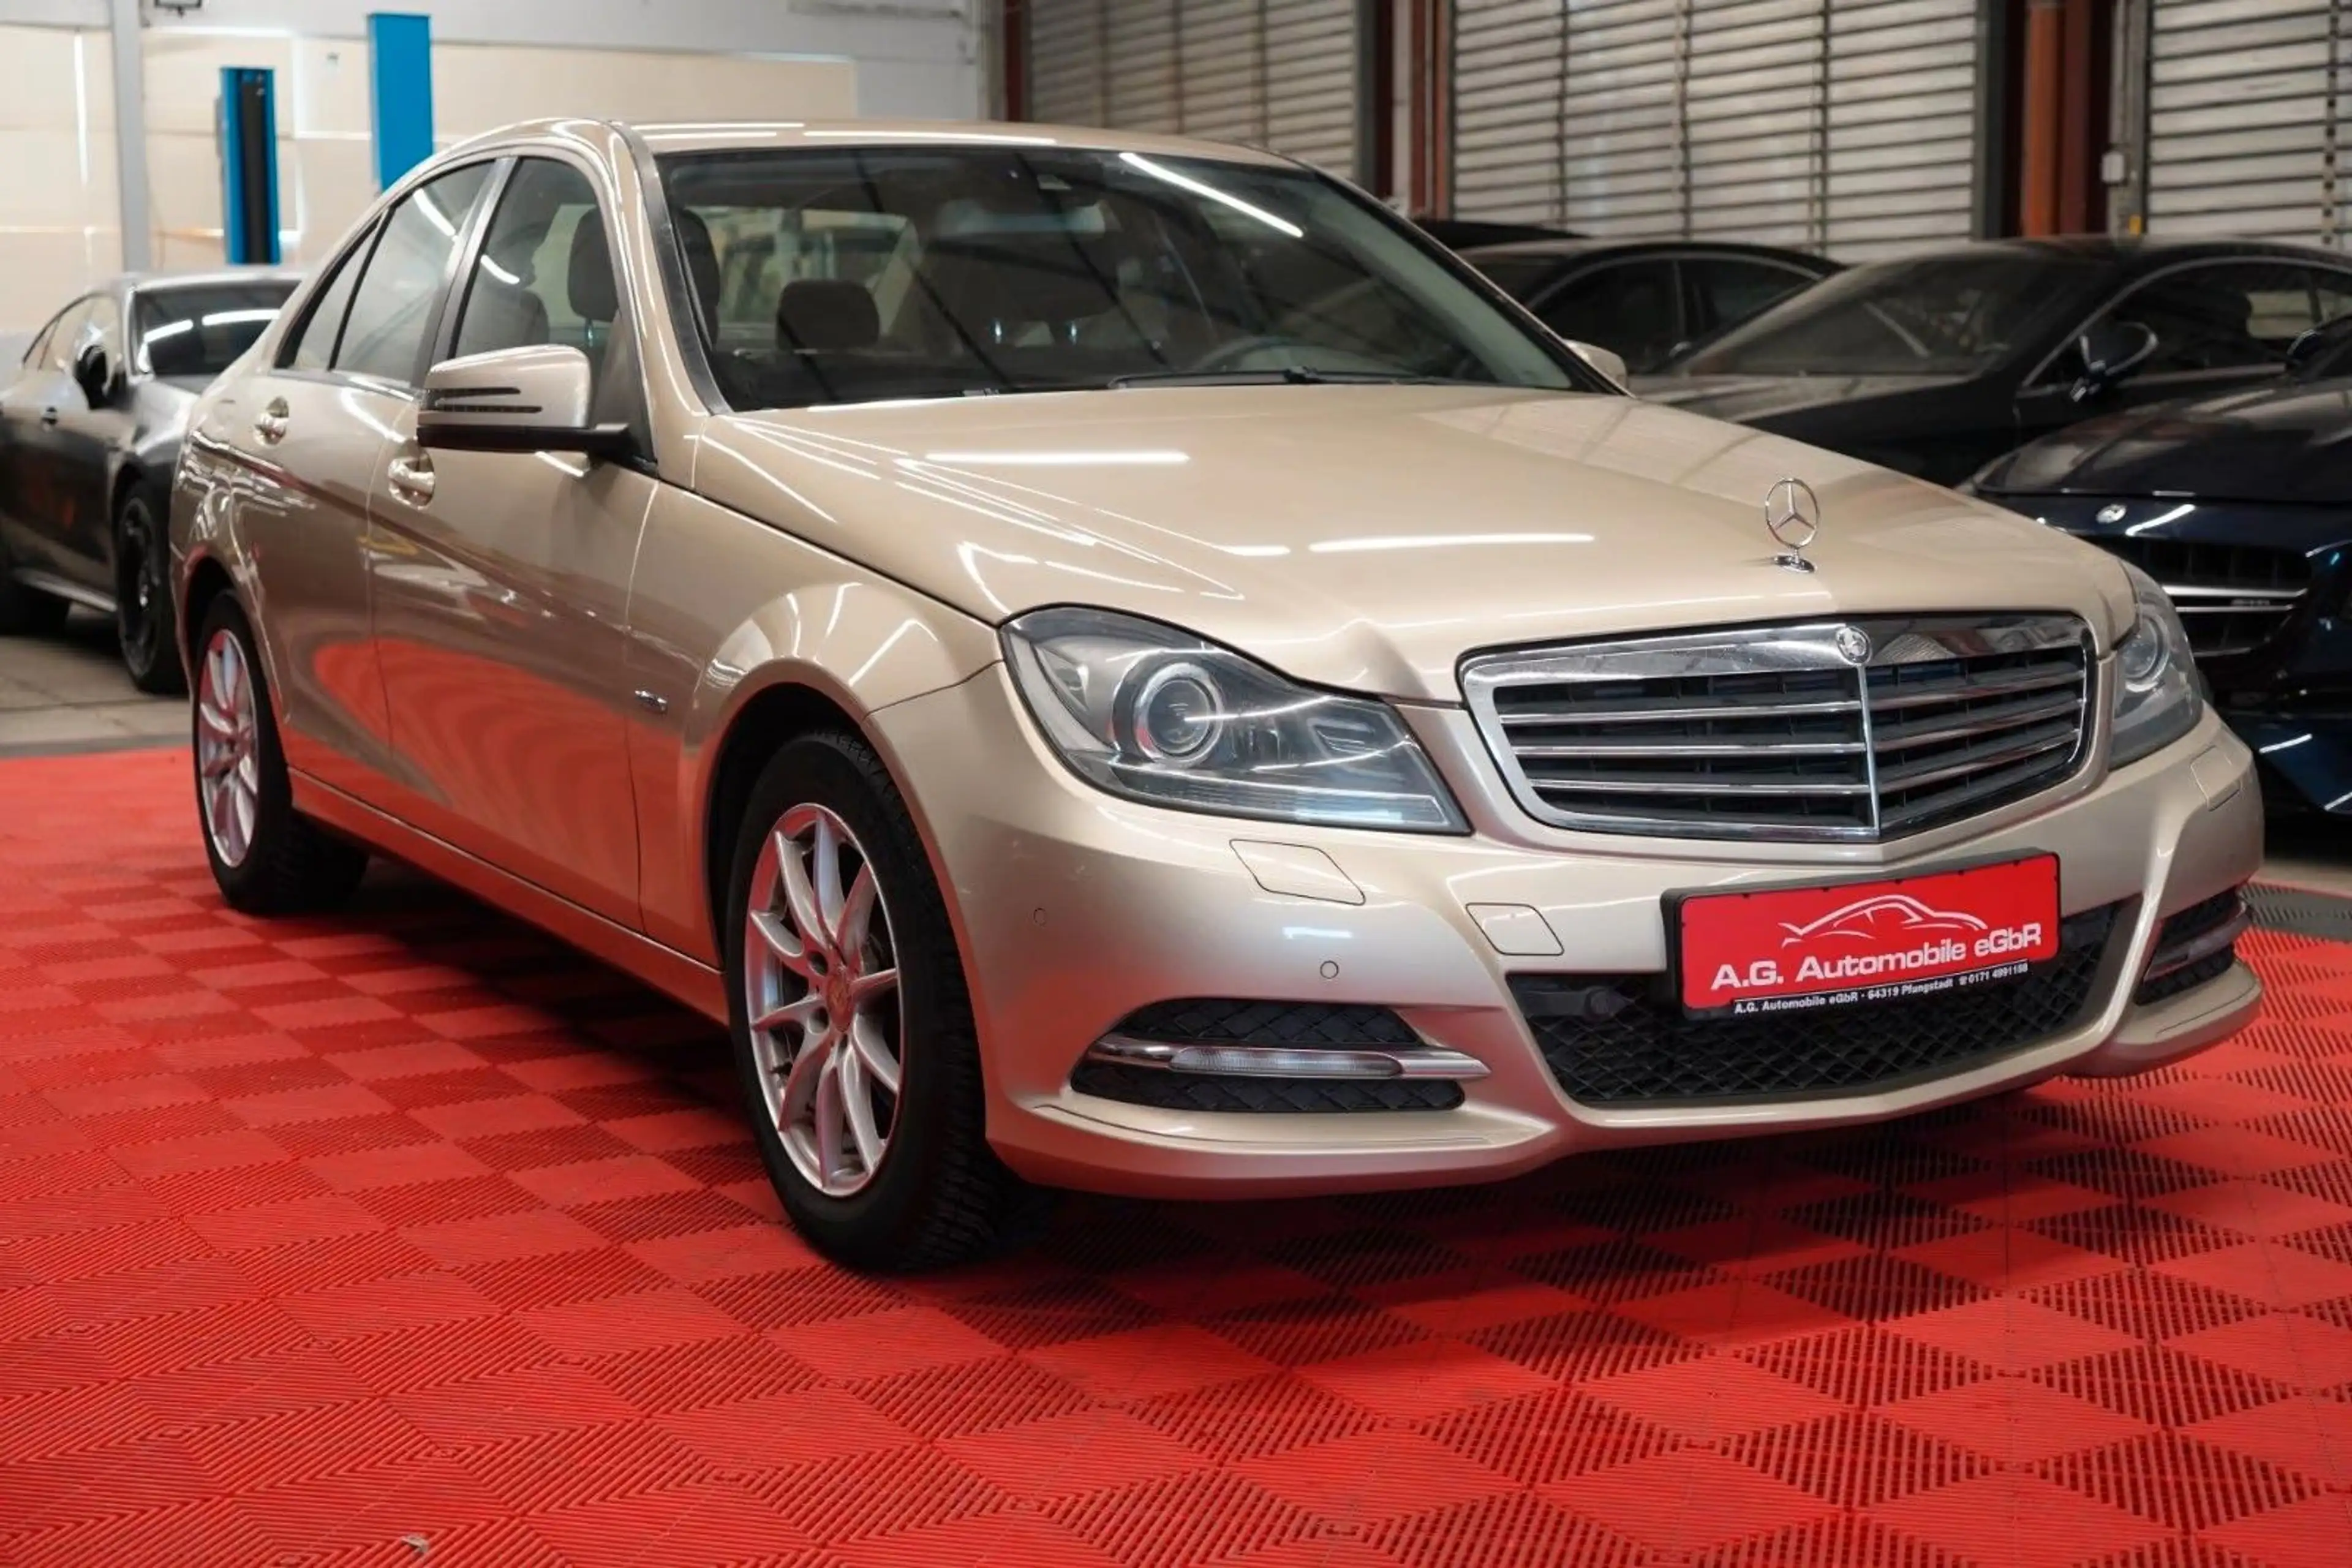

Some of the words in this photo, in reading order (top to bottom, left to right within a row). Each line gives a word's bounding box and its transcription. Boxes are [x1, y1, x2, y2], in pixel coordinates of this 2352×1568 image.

[1711, 961, 1784, 990] A.G.
[1795, 939, 1966, 982] Automobile
[1974, 923, 2041, 957] eGbR
[1734, 1001, 1758, 1014] A.G.
[1762, 996, 1825, 1011] Automobile
[1829, 992, 1858, 1005] eGbR
[1868, 987, 1899, 1000] 64319
[1901, 978, 1953, 995] Pfungstadt
